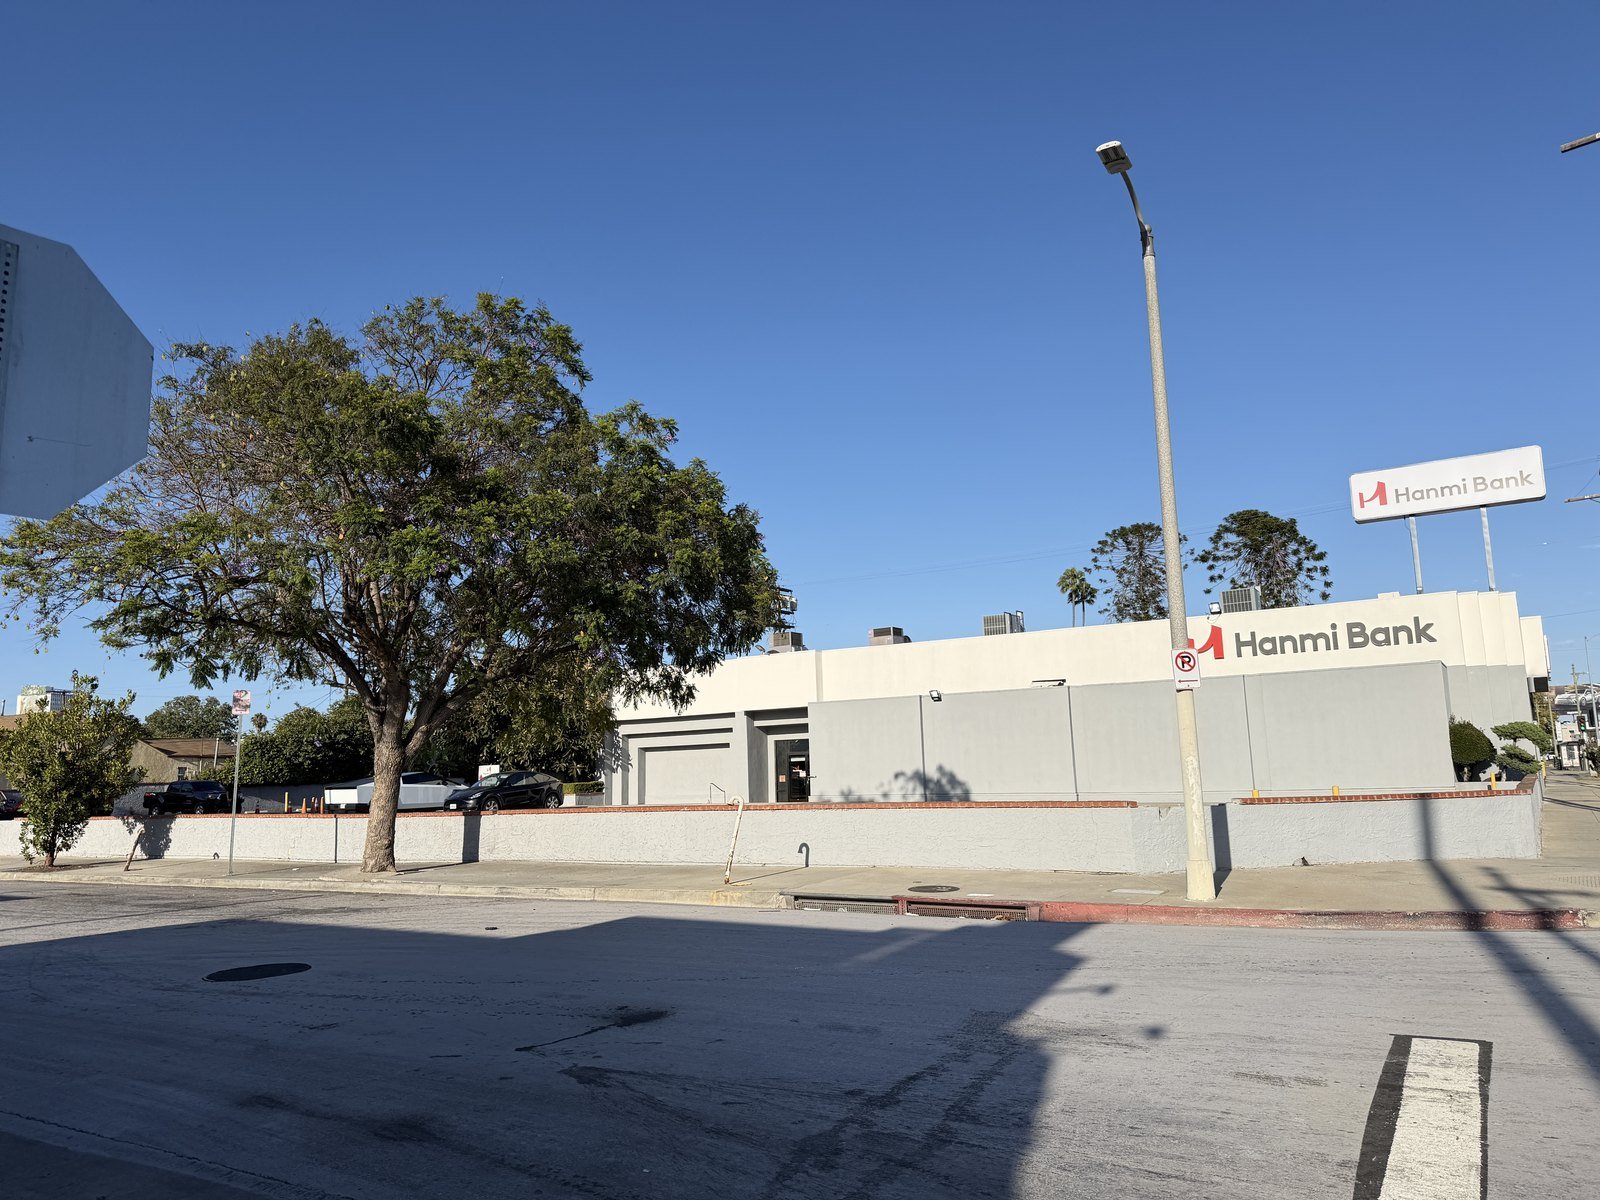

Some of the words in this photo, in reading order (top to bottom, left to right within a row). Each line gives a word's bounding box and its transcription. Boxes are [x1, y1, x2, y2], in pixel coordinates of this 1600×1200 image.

[1394, 478, 1468, 503] Hanmi
[1472, 470, 1535, 493] Bank
[1235, 623, 1339, 657] Hanmi
[1346, 616, 1437, 649] Bank
